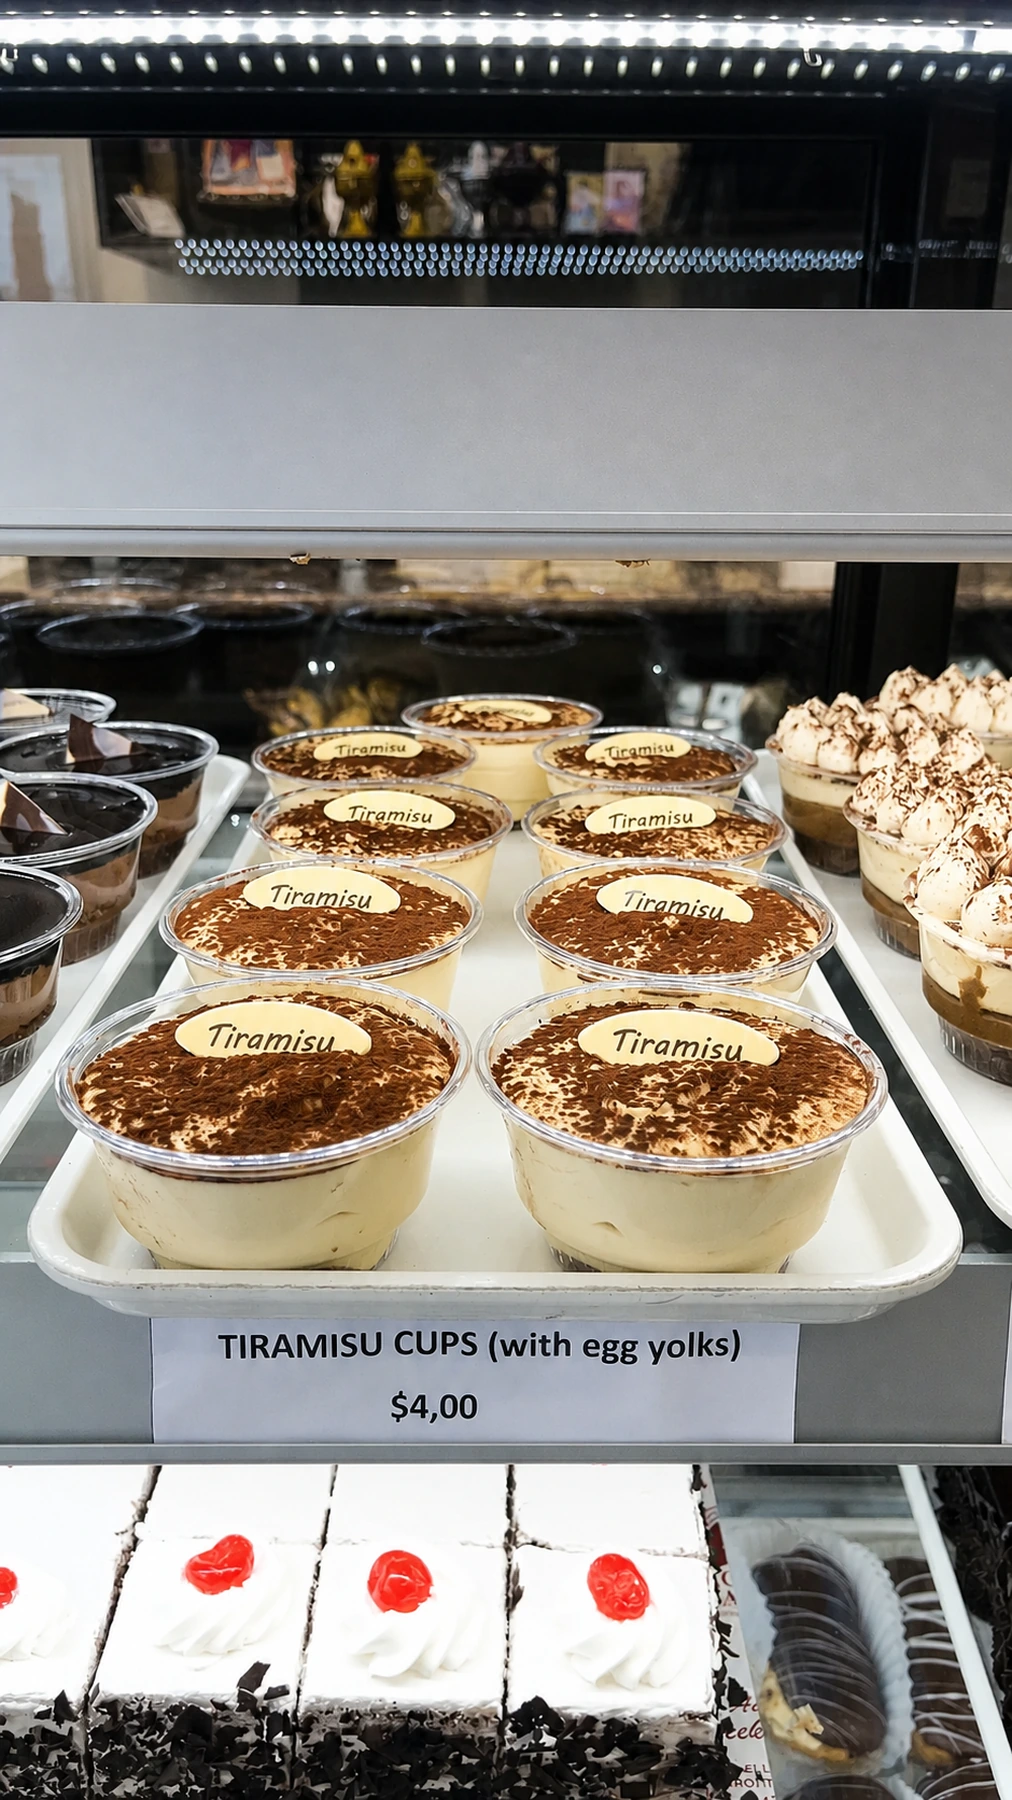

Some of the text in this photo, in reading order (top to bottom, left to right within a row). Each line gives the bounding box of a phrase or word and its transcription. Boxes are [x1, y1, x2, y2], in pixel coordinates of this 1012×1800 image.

[335, 742, 406, 756] Tiramisu
[604, 742, 674, 758] Tiramisu
[348, 805, 432, 824] Tiramisu
[608, 811, 693, 829] Tiramisu
[270, 884, 373, 909] Tiramisu
[624, 889, 725, 921] Tiramisu
[208, 1023, 335, 1052] Tiramisu
[613, 1029, 743, 1062] Tiramisu
[218, 1329, 741, 1366] TIRAMISU CUPS (with egg yolks)
[390, 1390, 478, 1424] $4,00
